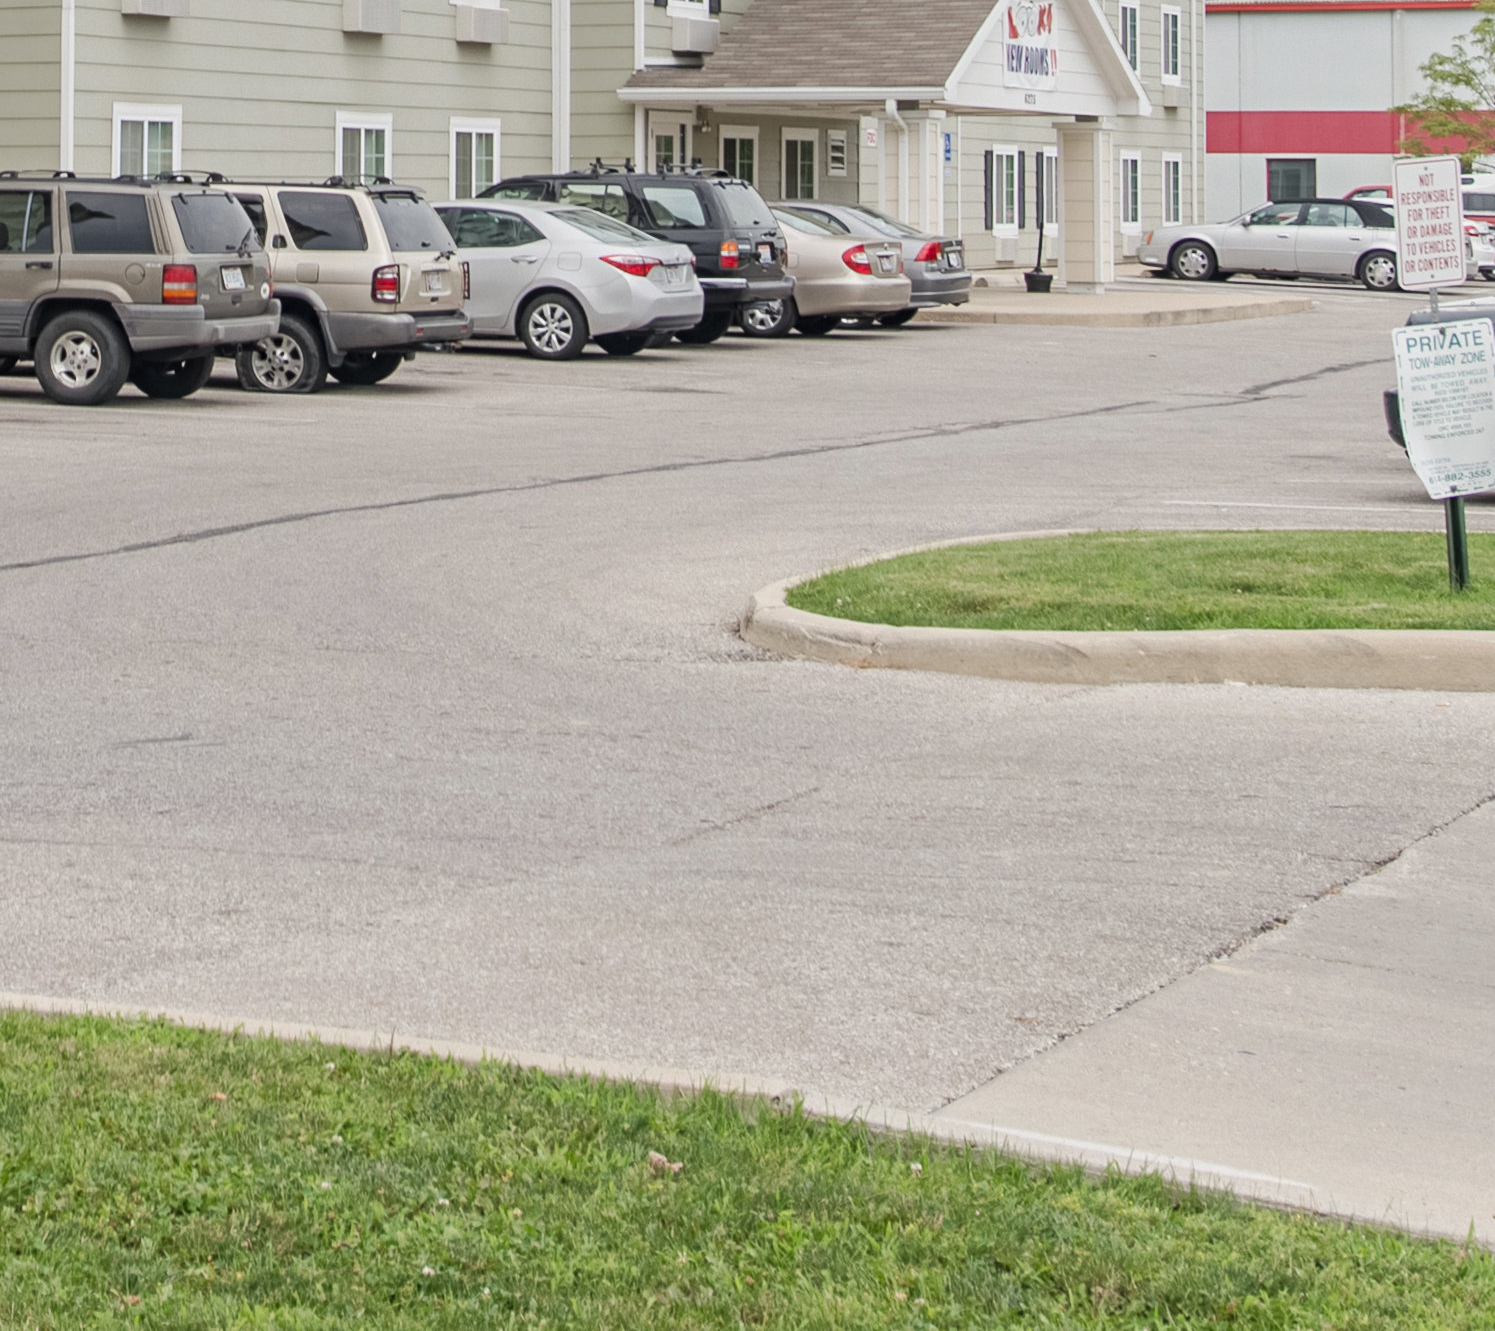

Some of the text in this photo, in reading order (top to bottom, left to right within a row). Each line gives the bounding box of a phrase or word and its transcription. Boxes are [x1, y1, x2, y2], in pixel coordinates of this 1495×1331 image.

[1418, 173, 1434, 187] NOT
[1400, 188, 1455, 206] RESPONSIBLE
[1408, 206, 1450, 222] FOR THEFT
[1407, 222, 1453, 239] OR DAMAGE
[1406, 239, 1456, 256] TO VEHICLES
[1405, 255, 1459, 273] OR CONTENTS
[1406, 330, 1484, 354] PRIVATE
[1408, 350, 1486, 370] TOW-AWAY ZONE
